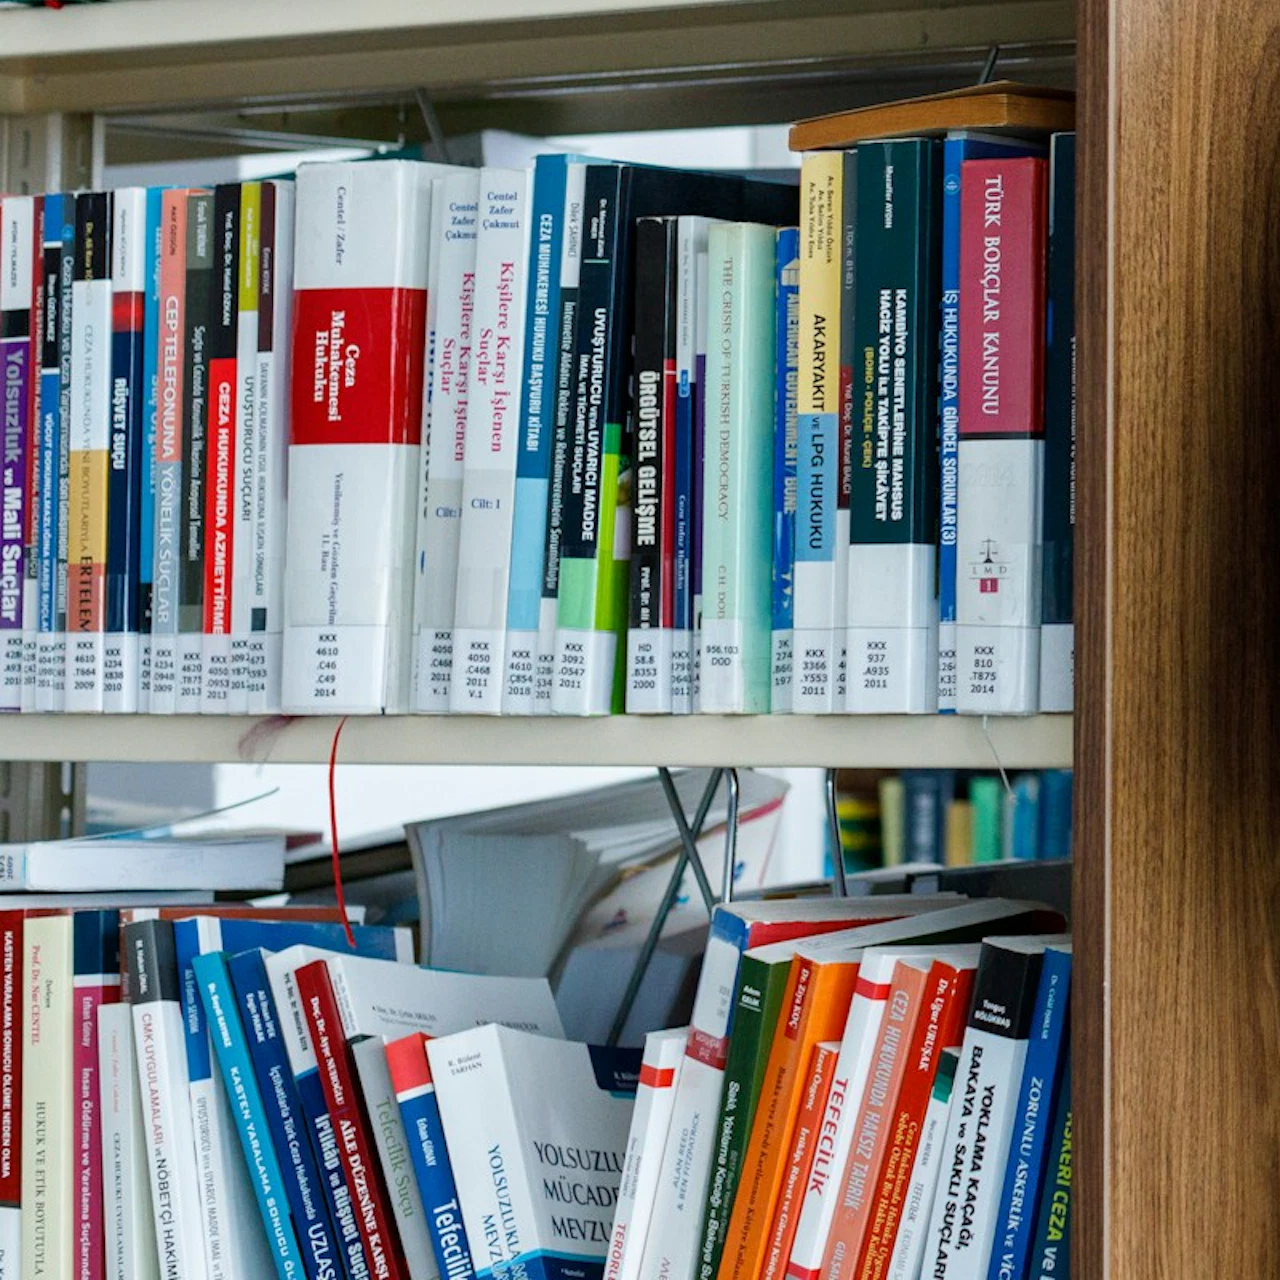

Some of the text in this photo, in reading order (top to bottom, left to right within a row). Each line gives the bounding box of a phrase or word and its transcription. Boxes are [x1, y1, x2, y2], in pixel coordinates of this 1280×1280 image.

[450, 202, 478, 212] Centel
[451, 216, 475, 226] Zafer
[482, 219, 519, 230] Çakmut
[487, 192, 518, 201] Centel
[489, 206, 515, 215] Zafer
[879, 289, 894, 334] HACİZ
[980, 174, 1004, 415] TÜRK BORÇLAR KANUNU
[476, 328, 493, 385] Suçlar
[491, 262, 514, 452] Kişilere Karşı İşlenen
[526, 213, 553, 452] CEZA MUHAKEMESİ HUKUKU BAŞVURU KİTABI
[878, 336, 891, 374] YOLU
[313, 330, 327, 403] Hukuku
[327, 310, 346, 421] Muhakemesi
[344, 344, 361, 388] Ceza
[439, 338, 456, 395] Suçlar
[717, 257, 733, 521] THE CRISIS OF TURKISH DEMOCRACY
[877, 376, 889, 396] İLE
[112, 377, 129, 470] RÜŞVET SUÇU
[807, 314, 827, 551] AKARYAKIT VE LPG HUKUKU
[875, 399, 891, 458] TAKİPTE
[890, 289, 908, 521] KAMBİYO SENETLERİNE MAHSUS
[157, 296, 178, 624] CEP TELEFONUNA YÖNELİK SUÇLAR
[241, 376, 254, 521] UYUŞTURUCU SUÇLARI
[634, 371, 660, 546] ÖRGÜTSEL GELİŞME
[0, 350, 24, 622] Yolsuzluk ve Mali Suçlar
[212, 381, 231, 634] CEZA HUKUKUNDA AZMETTİRME
[316, 647, 338, 656] 4610
[319, 634, 337, 643] KKX
[562, 654, 585, 665] 3092
[802, 661, 827, 671] 3366
[805, 649, 825, 658] KKX
[866, 654, 886, 663] 937
[867, 641, 887, 651] KKX
[974, 646, 994, 656] KKX
[974, 659, 993, 668] 810
[314, 688, 336, 698] 2014
[559, 678, 582, 689] 2011
[801, 686, 825, 696] 2011
[864, 679, 887, 689] 2011
[970, 684, 994, 694] 2014
[843, 990, 910, 1211] CEZA HUKUKUNDA HAKSIZ TAHRİK
[230, 1066, 290, 1257] KASTEN YARALAMA SONUCU
[376, 1096, 415, 1219] Tefecilik Suçu
[810, 1078, 849, 1196] TEFECİLİK
[1003, 1075, 1043, 1248] ZORUNLU ASKERLİK VE
[34, 1102, 46, 1276] HUKUK VE ETİK BOYUTUYLA
[954, 1084, 996, 1251] YOKLAMA KAÇAĞI,
